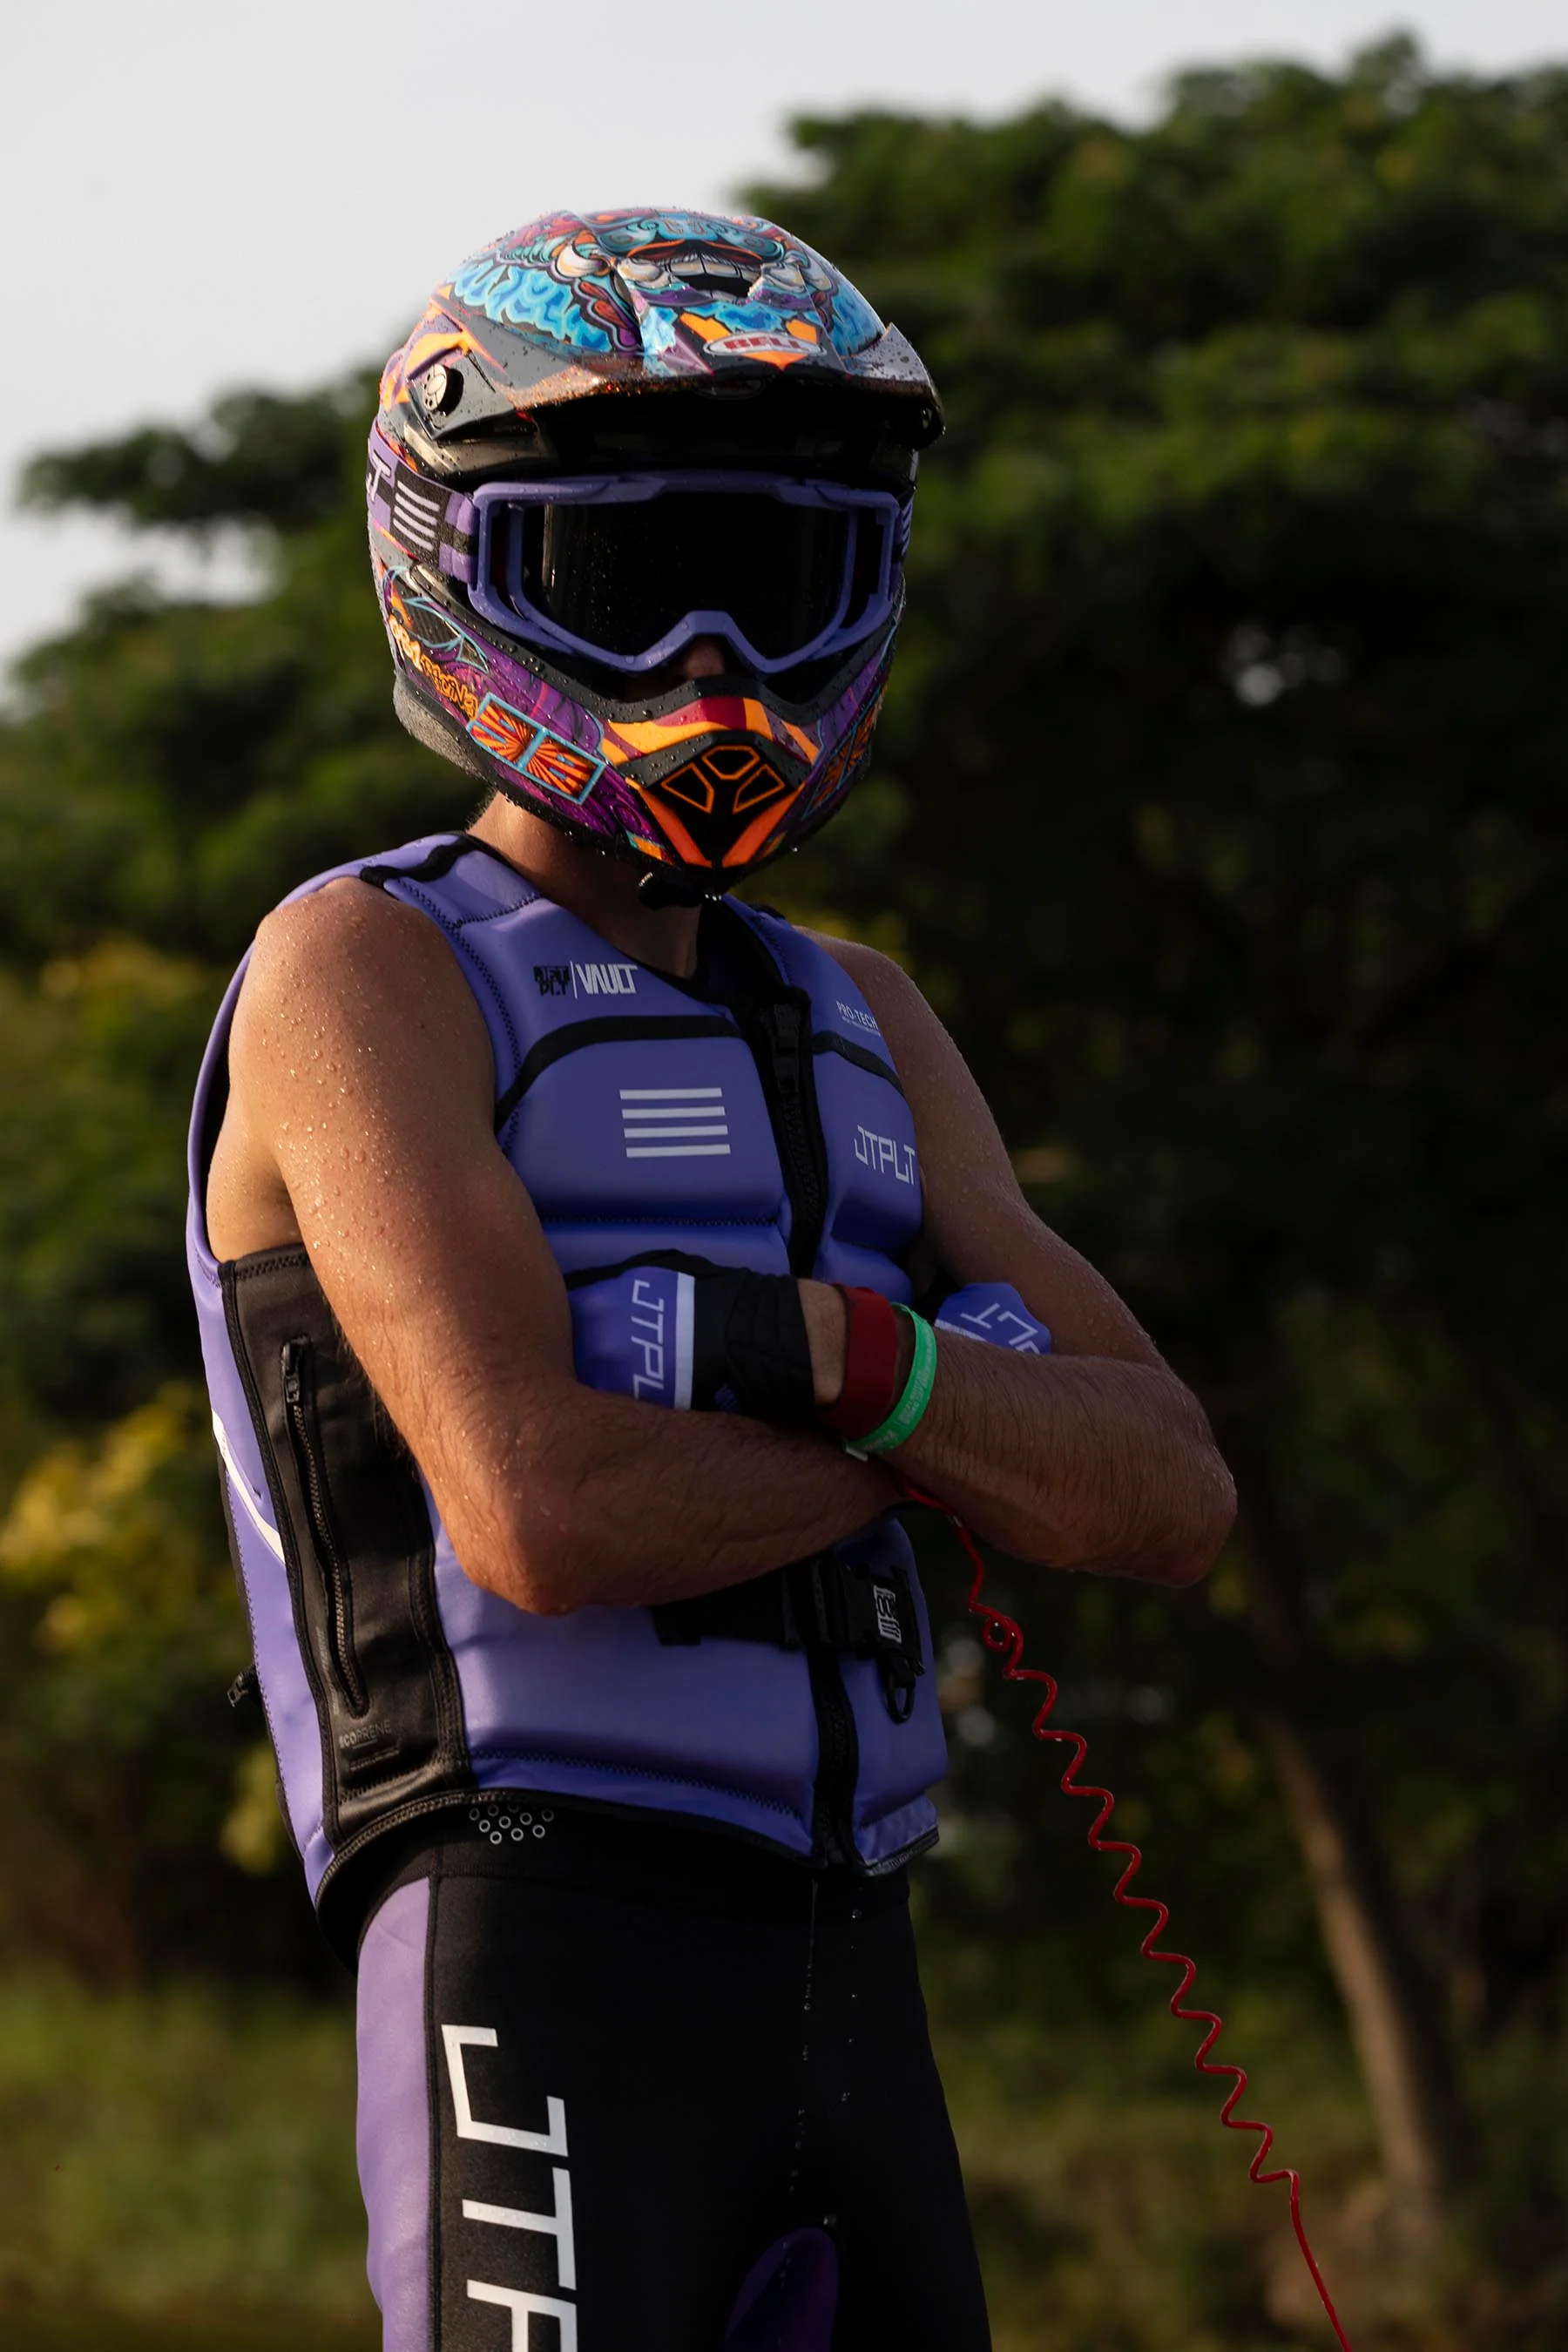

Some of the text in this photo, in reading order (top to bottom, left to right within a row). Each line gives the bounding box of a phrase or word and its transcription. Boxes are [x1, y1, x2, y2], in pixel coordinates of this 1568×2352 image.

[722, 335, 809, 351] BELL
[575, 963, 639, 995] VAULT
[854, 1124, 916, 1186] JTPLT
